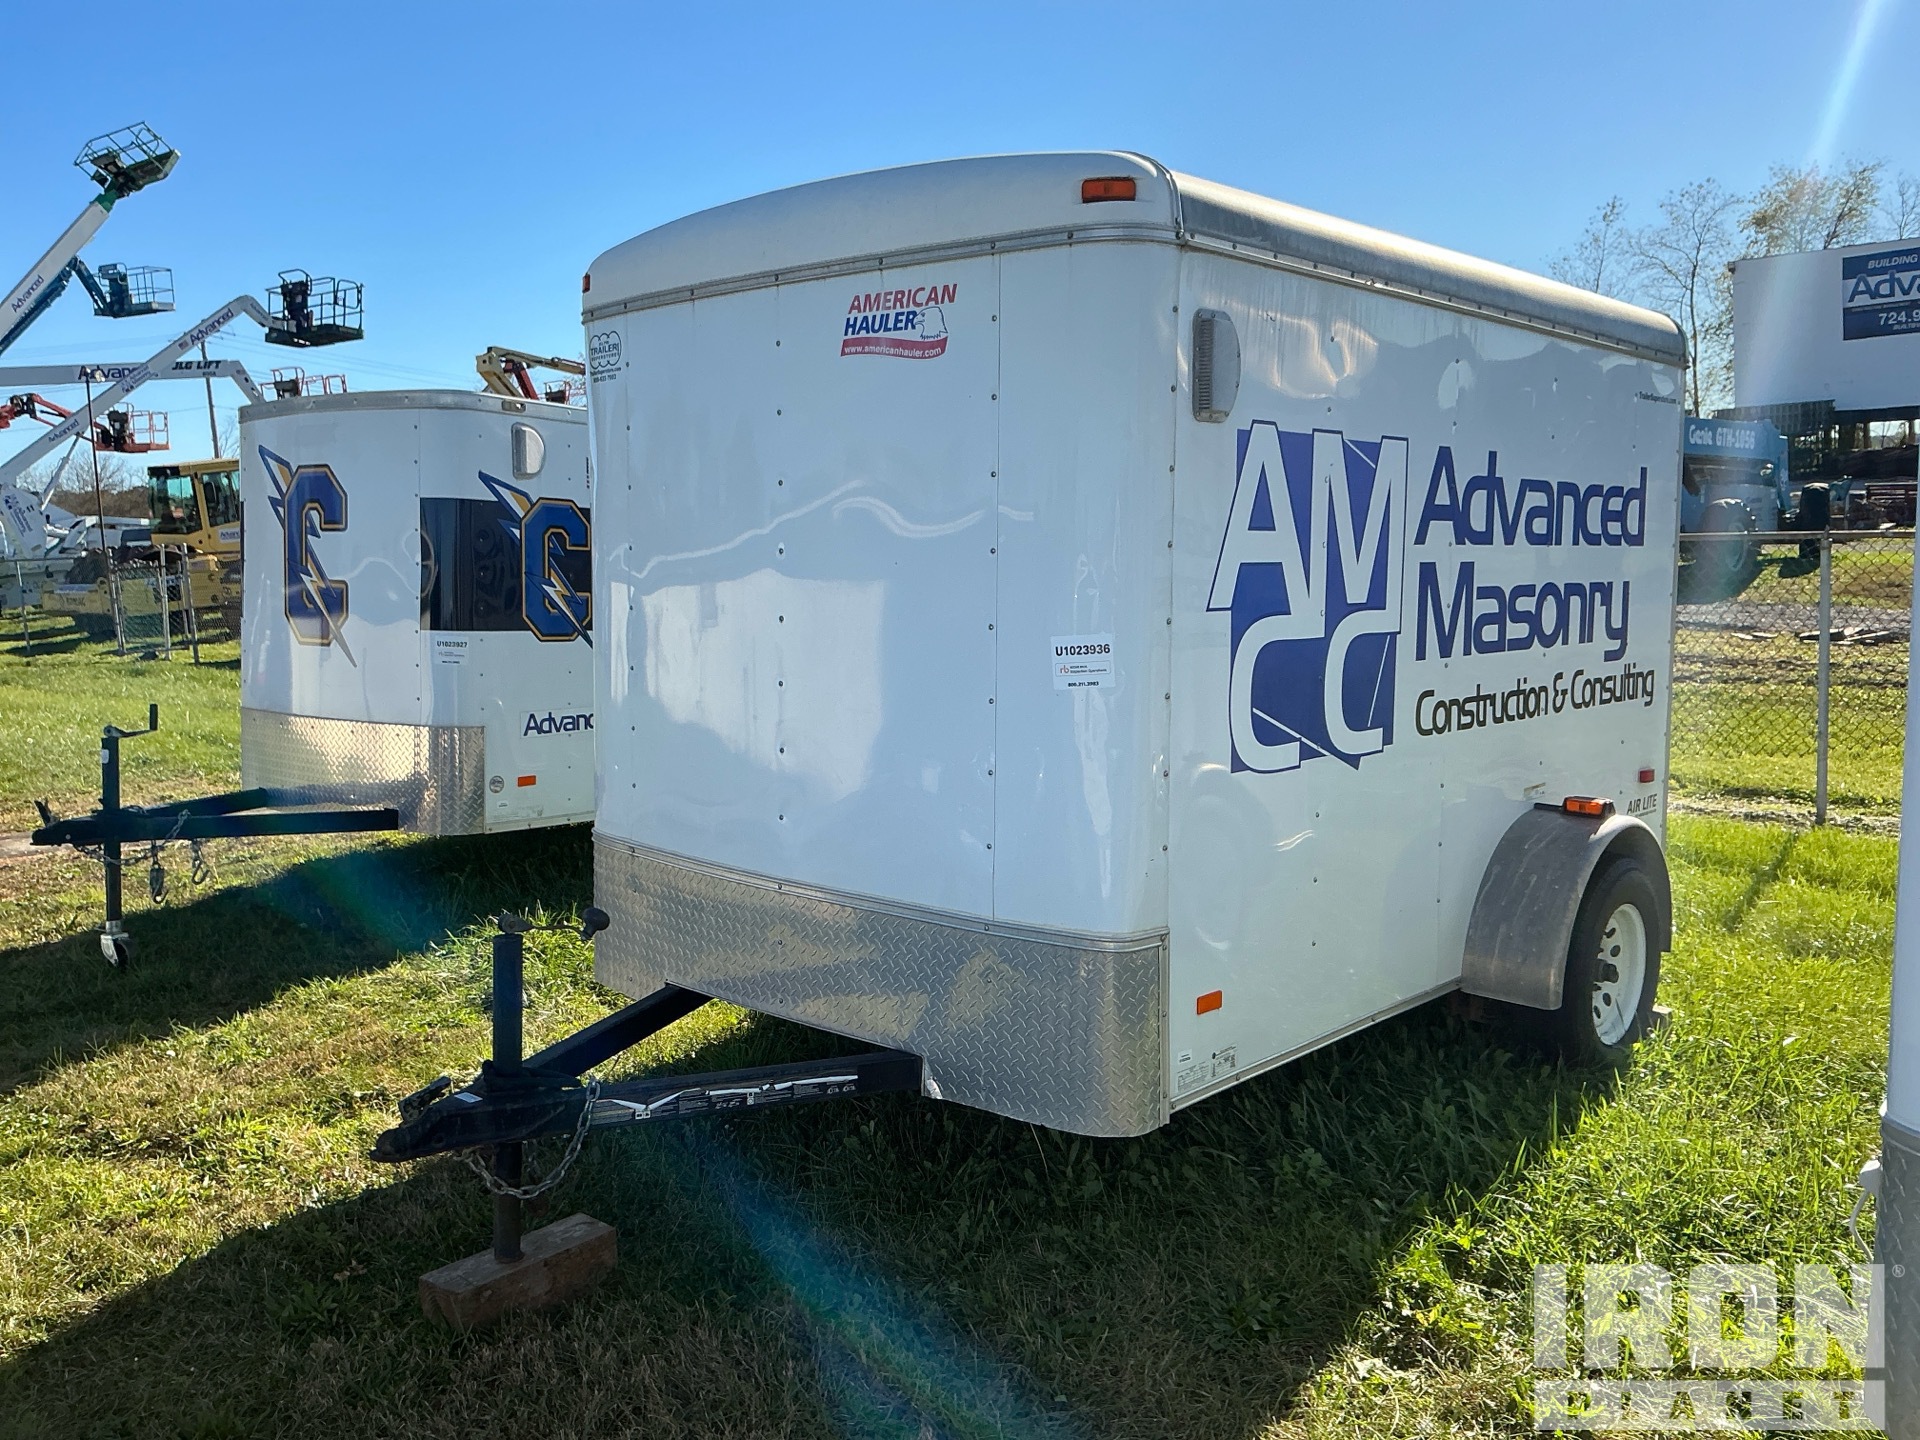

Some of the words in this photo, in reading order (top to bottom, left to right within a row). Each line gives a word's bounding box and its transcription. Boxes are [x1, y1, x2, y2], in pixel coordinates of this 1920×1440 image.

[1868, 254, 1918, 269] BUILDING
[11, 274, 45, 313] Advanced
[1848, 269, 1920, 303] Adv
[848, 284, 958, 314] AMERICAN
[190, 308, 234, 345] Advanced
[844, 311, 918, 336] HAULER
[844, 345, 942, 358] www.americanhauler.com
[78, 364, 141, 381] Advan
[171, 361, 194, 370] JLG
[196, 360, 222, 369] LIFT
[48, 418, 80, 442] Advanced
[1689, 424, 1713, 446] Genie
[1413, 446, 1648, 547] Advanced
[1415, 561, 1630, 663] Masonry
[1055, 643, 1111, 657] U1023936
[1415, 677, 1549, 736] Construction
[1553, 672, 1569, 714] &
[1571, 662, 1655, 708] Consulting
[1627, 798, 1642, 815] AIR
[1643, 793, 1658, 810] LITE
